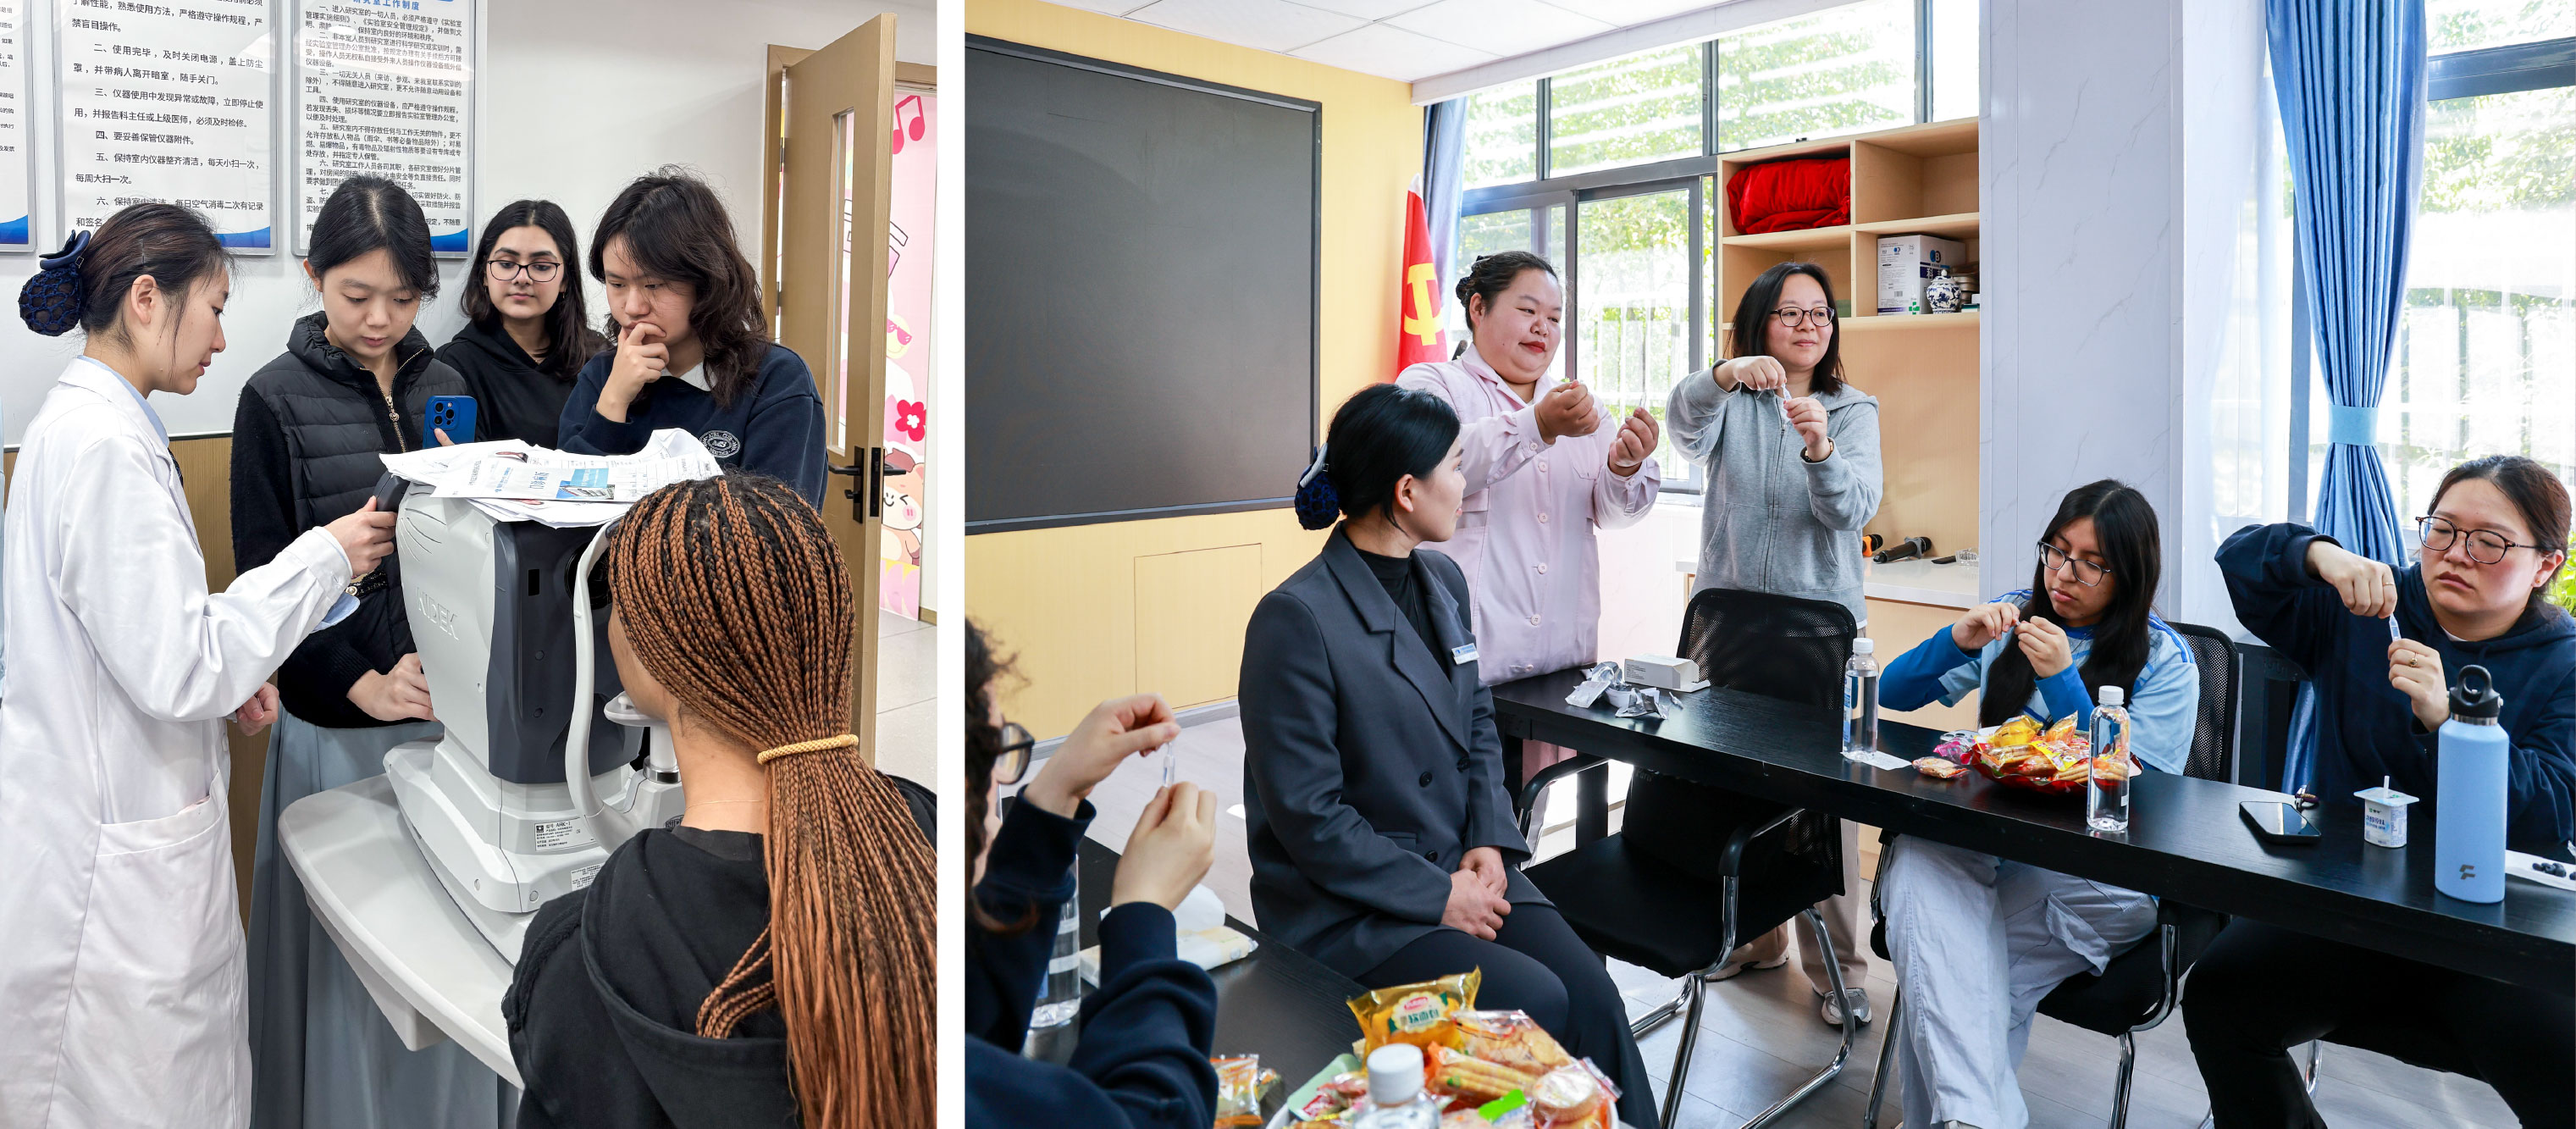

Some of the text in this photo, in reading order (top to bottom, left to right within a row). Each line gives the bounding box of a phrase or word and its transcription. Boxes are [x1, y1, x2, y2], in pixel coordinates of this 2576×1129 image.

[72, 18, 121, 32] 禁盲目操作。
[75, 173, 132, 185] 每周大扫一次。
[75, 217, 102, 227] 和签名
